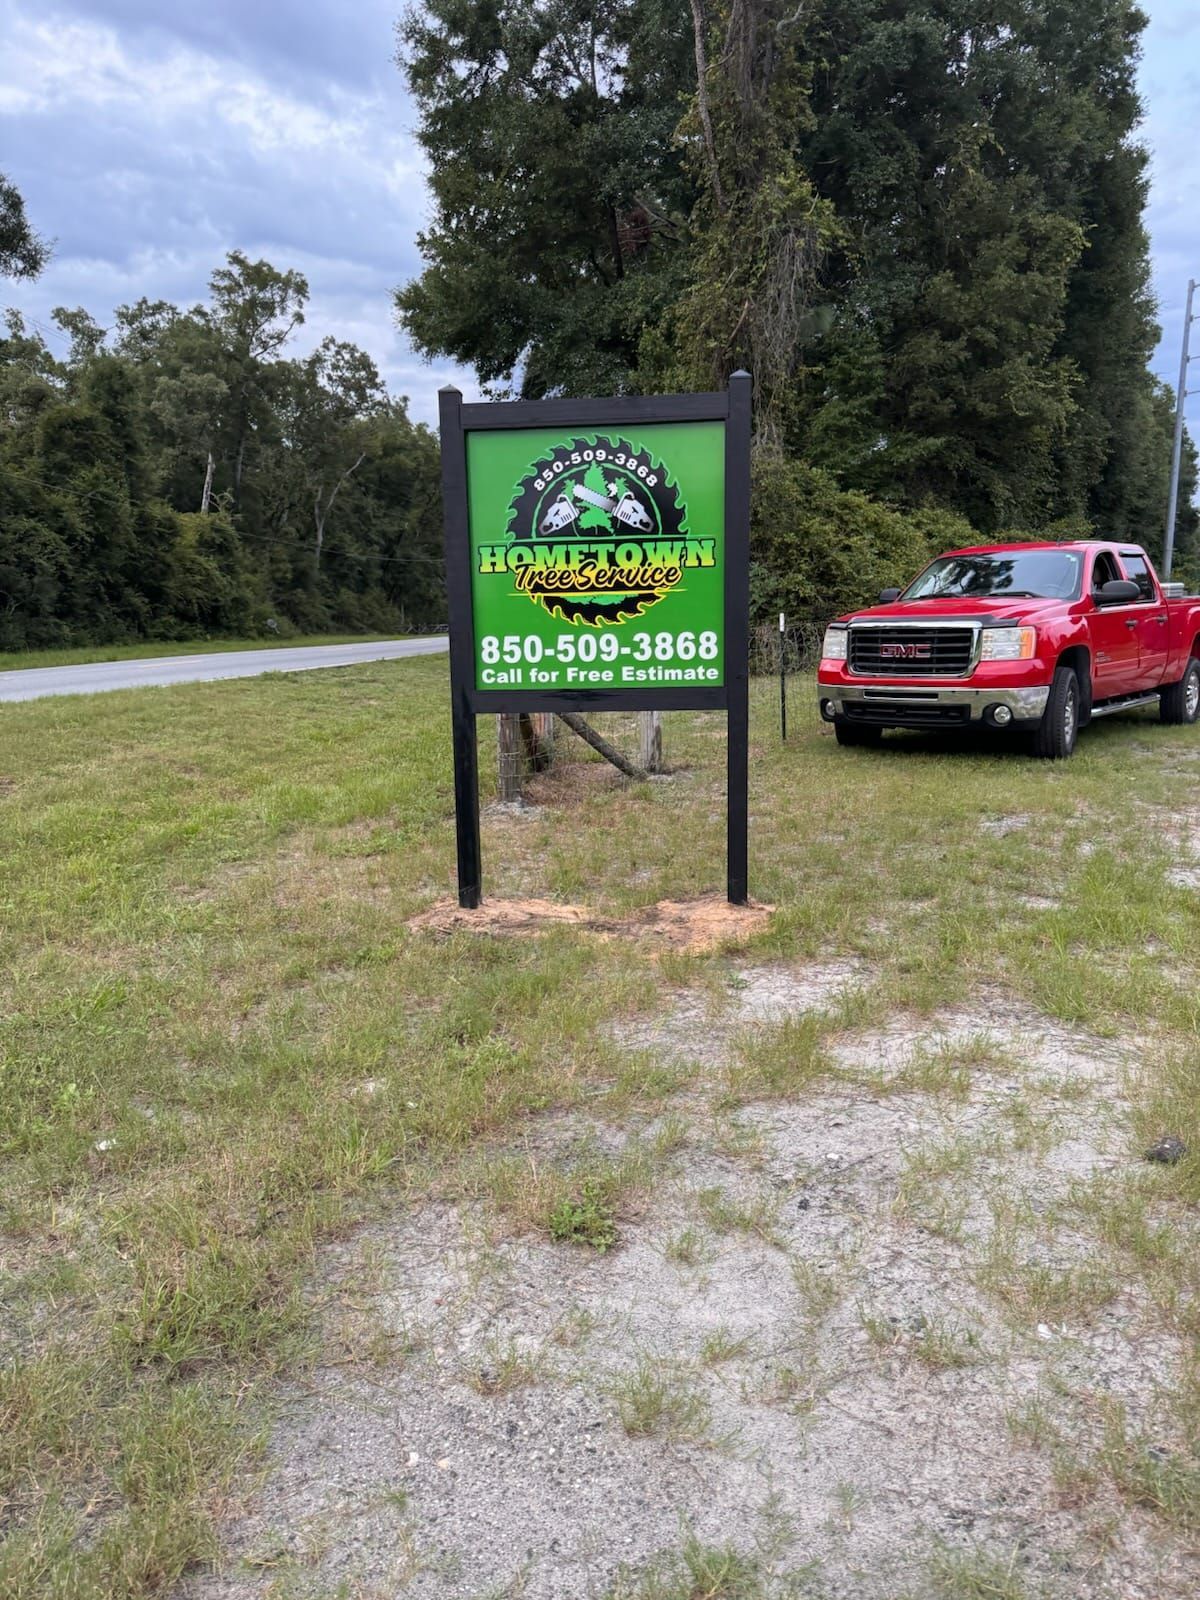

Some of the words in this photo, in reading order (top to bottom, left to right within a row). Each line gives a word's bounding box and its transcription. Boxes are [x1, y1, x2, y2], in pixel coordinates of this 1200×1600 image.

[533, 449, 658, 491] 850-509-3868
[478, 539, 716, 573] HOMETOWN
[515, 562, 574, 590] Tree
[575, 558, 682, 590] Service
[481, 631, 718, 663] 850-509-3868
[880, 643, 931, 658] GMC
[481, 668, 522, 684] Call
[529, 667, 558, 683] for
[567, 667, 613, 682] Free
[621, 666, 719, 681] Estimate
